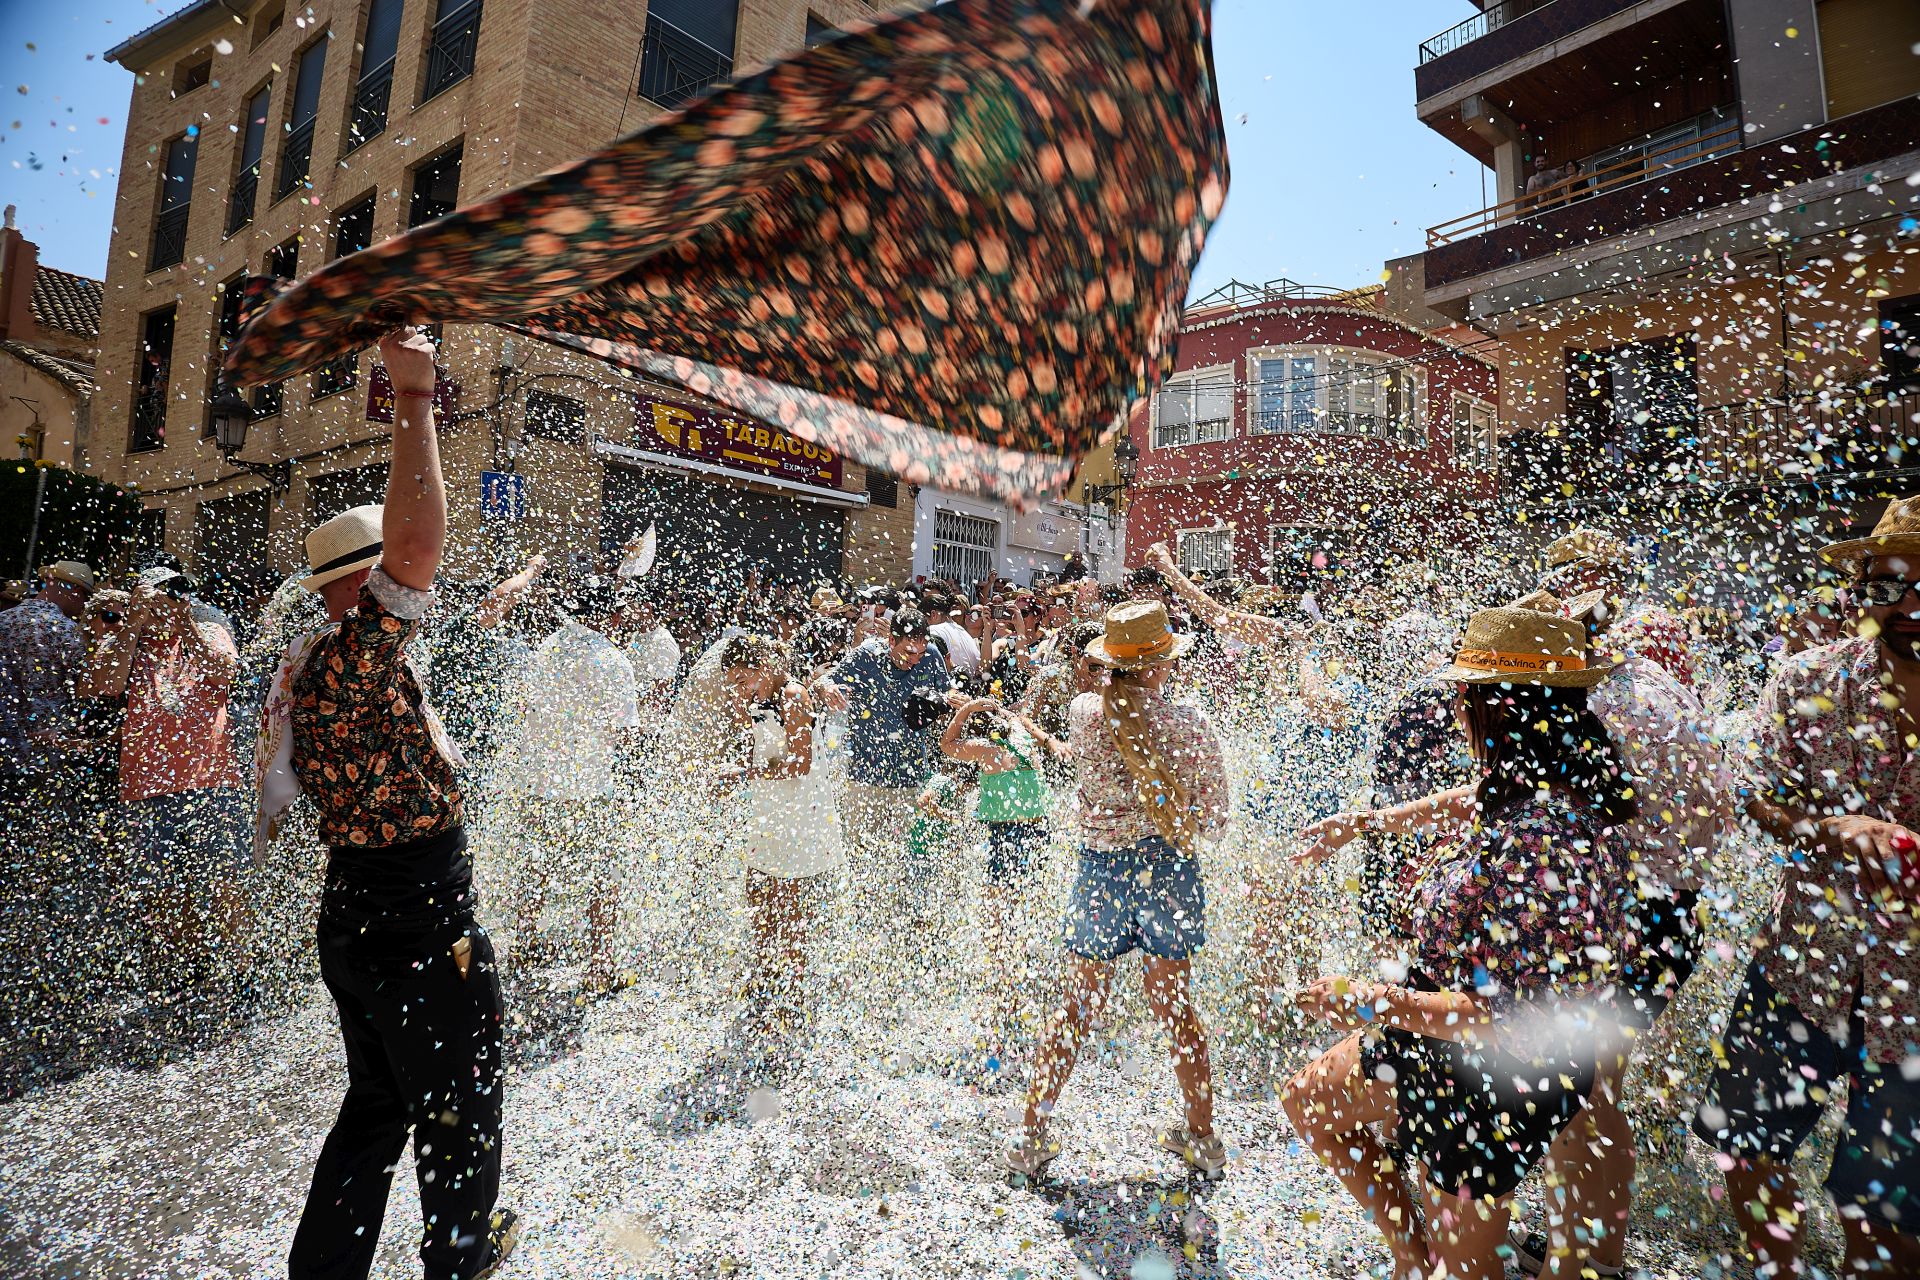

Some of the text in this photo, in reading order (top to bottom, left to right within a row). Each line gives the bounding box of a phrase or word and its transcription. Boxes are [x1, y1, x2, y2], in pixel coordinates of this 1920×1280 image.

[721, 419, 833, 463] TABACOS
[1498, 656, 1537, 669] Fadrina
[1538, 659, 1564, 671] 209
